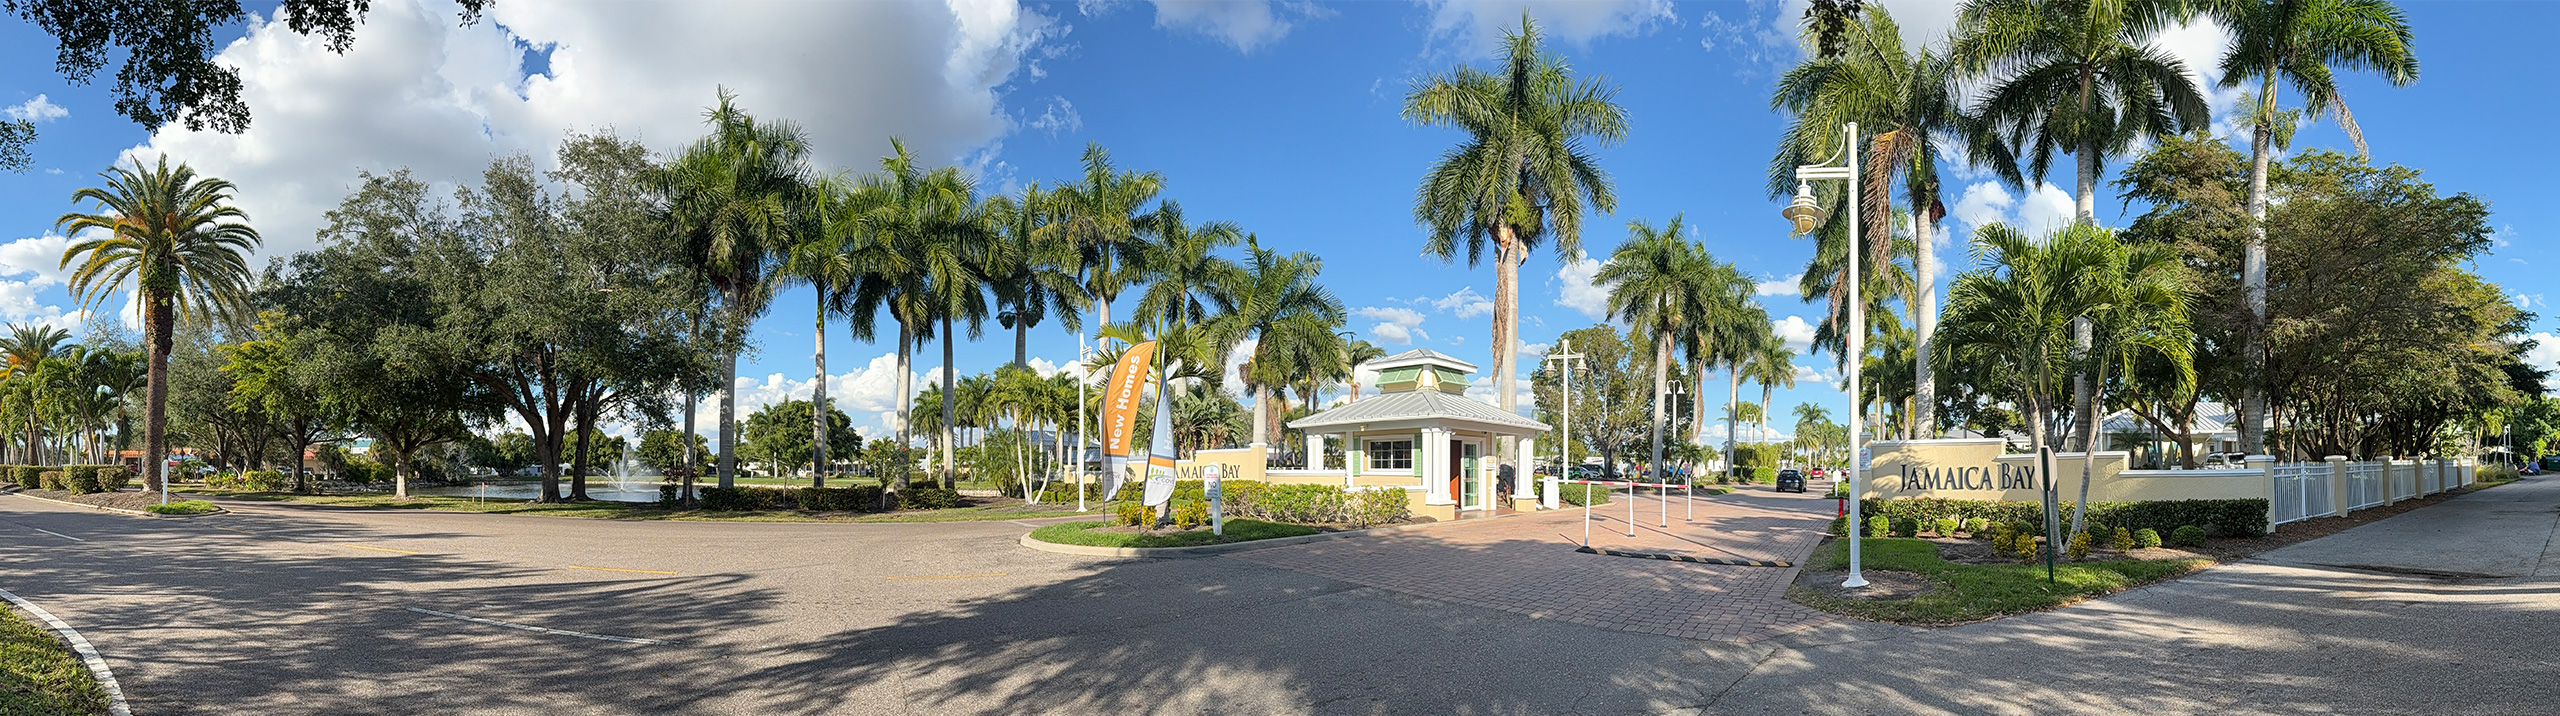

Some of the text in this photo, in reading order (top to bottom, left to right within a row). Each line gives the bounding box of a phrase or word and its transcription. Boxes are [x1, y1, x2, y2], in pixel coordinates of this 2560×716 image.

[1109, 355, 1140, 450] New Homes
[1221, 463, 1241, 479] BAY
[1900, 462, 2035, 493] JAMAICA BAY
